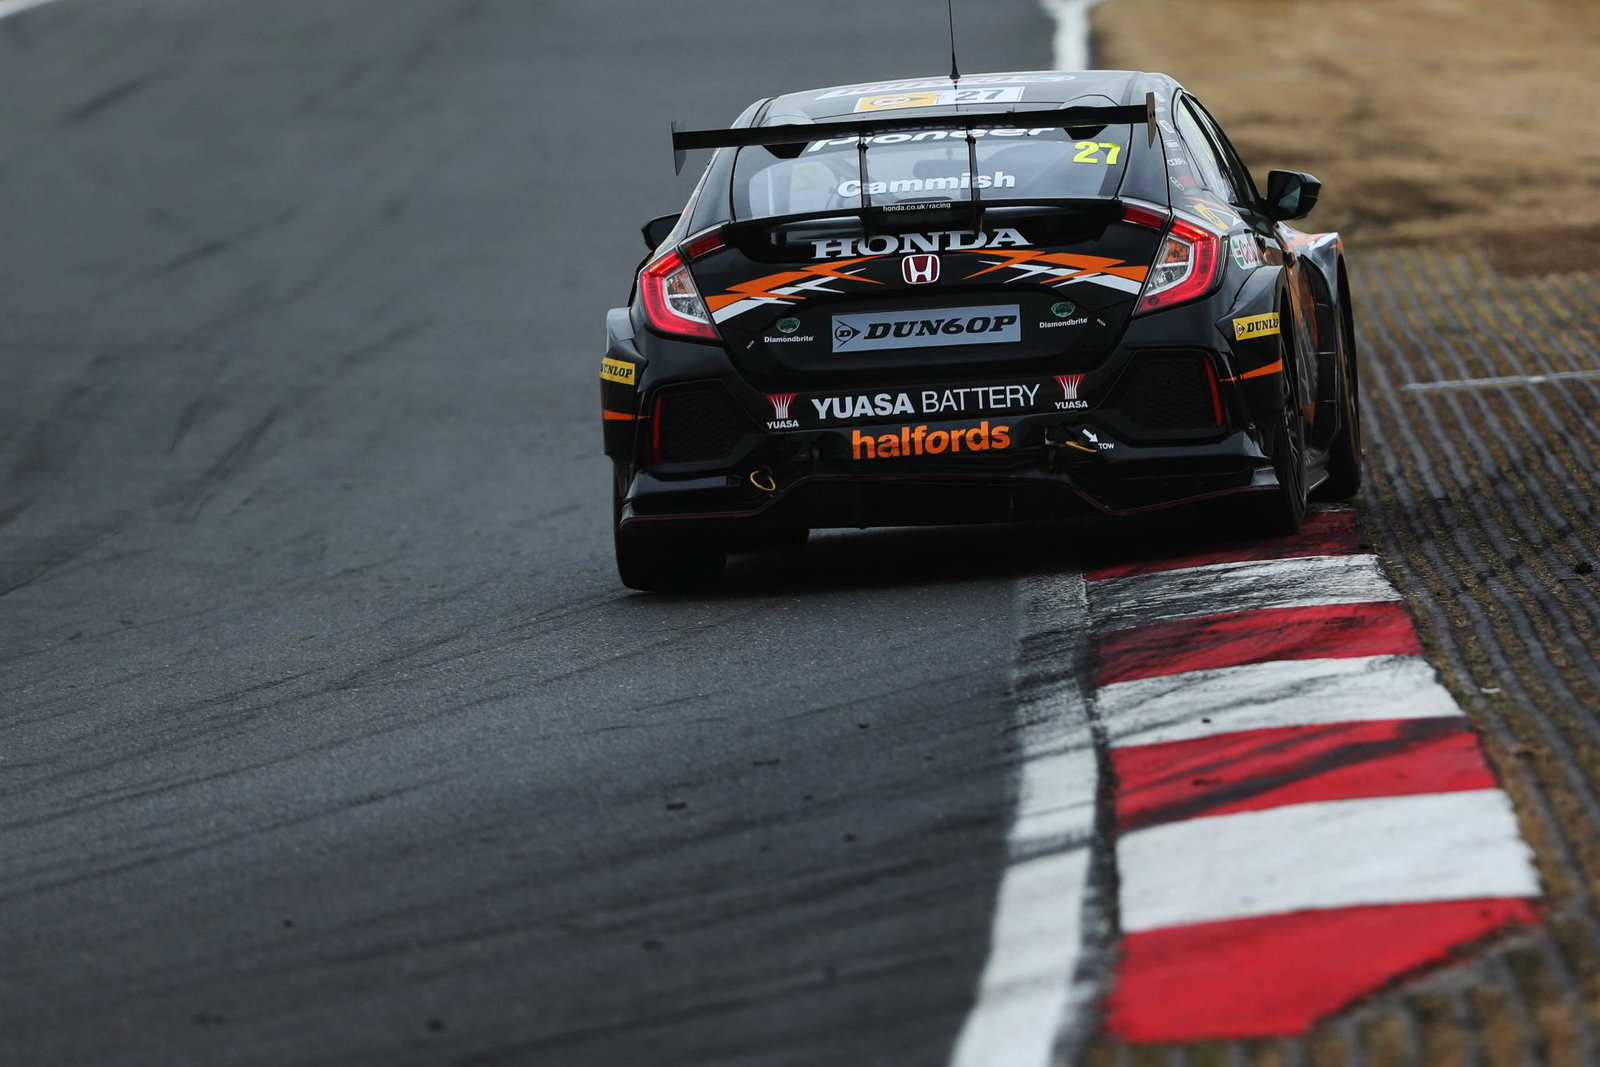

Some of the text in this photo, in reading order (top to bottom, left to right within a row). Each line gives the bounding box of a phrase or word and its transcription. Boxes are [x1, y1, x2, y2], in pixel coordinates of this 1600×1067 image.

[955, 89, 1005, 101] 27
[1073, 141, 1120, 165] 27
[837, 171, 1016, 198] Cammish
[883, 202, 951, 212] honda.co.uk/racing
[811, 228, 1034, 259] HONDA
[1039, 317, 1087, 328] Diamondbrite
[764, 335, 813, 343] Diamondbrite
[811, 383, 1040, 420] YUASA BATTERY
[1055, 400, 1088, 410] YUASA
[767, 419, 799, 430] YUASA
[852, 421, 1011, 460] halfords
[1098, 442, 1115, 450] TOW
